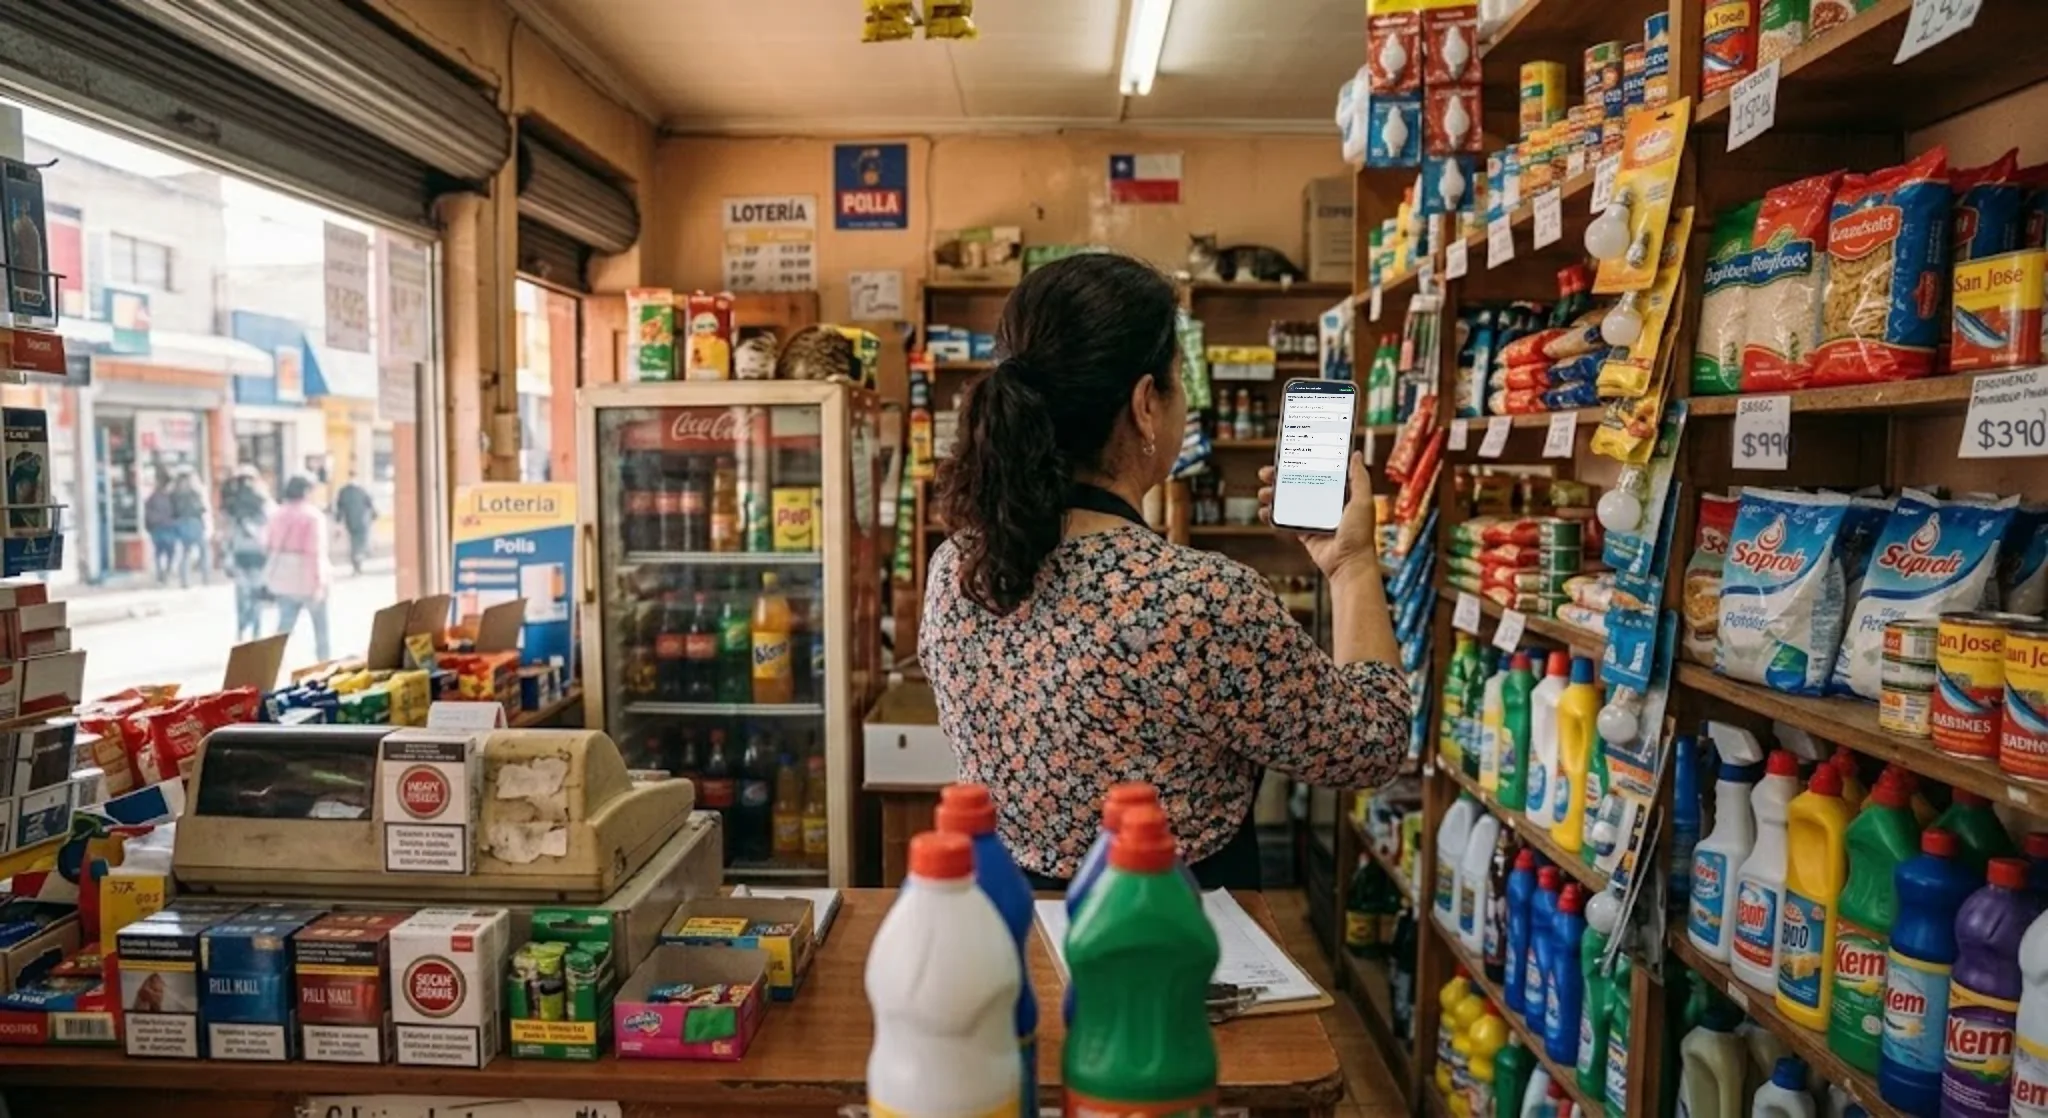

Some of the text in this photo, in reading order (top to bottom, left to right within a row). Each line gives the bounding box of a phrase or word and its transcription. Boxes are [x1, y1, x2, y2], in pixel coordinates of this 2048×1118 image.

[731, 200, 807, 223] LOTERÍA
[842, 191, 899, 214] POLLA
[1955, 275, 1982, 293] San
[1977, 418, 2046, 451] $390
[1960, 632, 2002, 654] Jose
[1836, 942, 1886, 977] Kem
[1946, 1016, 2014, 1056] Kem
[2012, 1071, 2048, 1107] em
